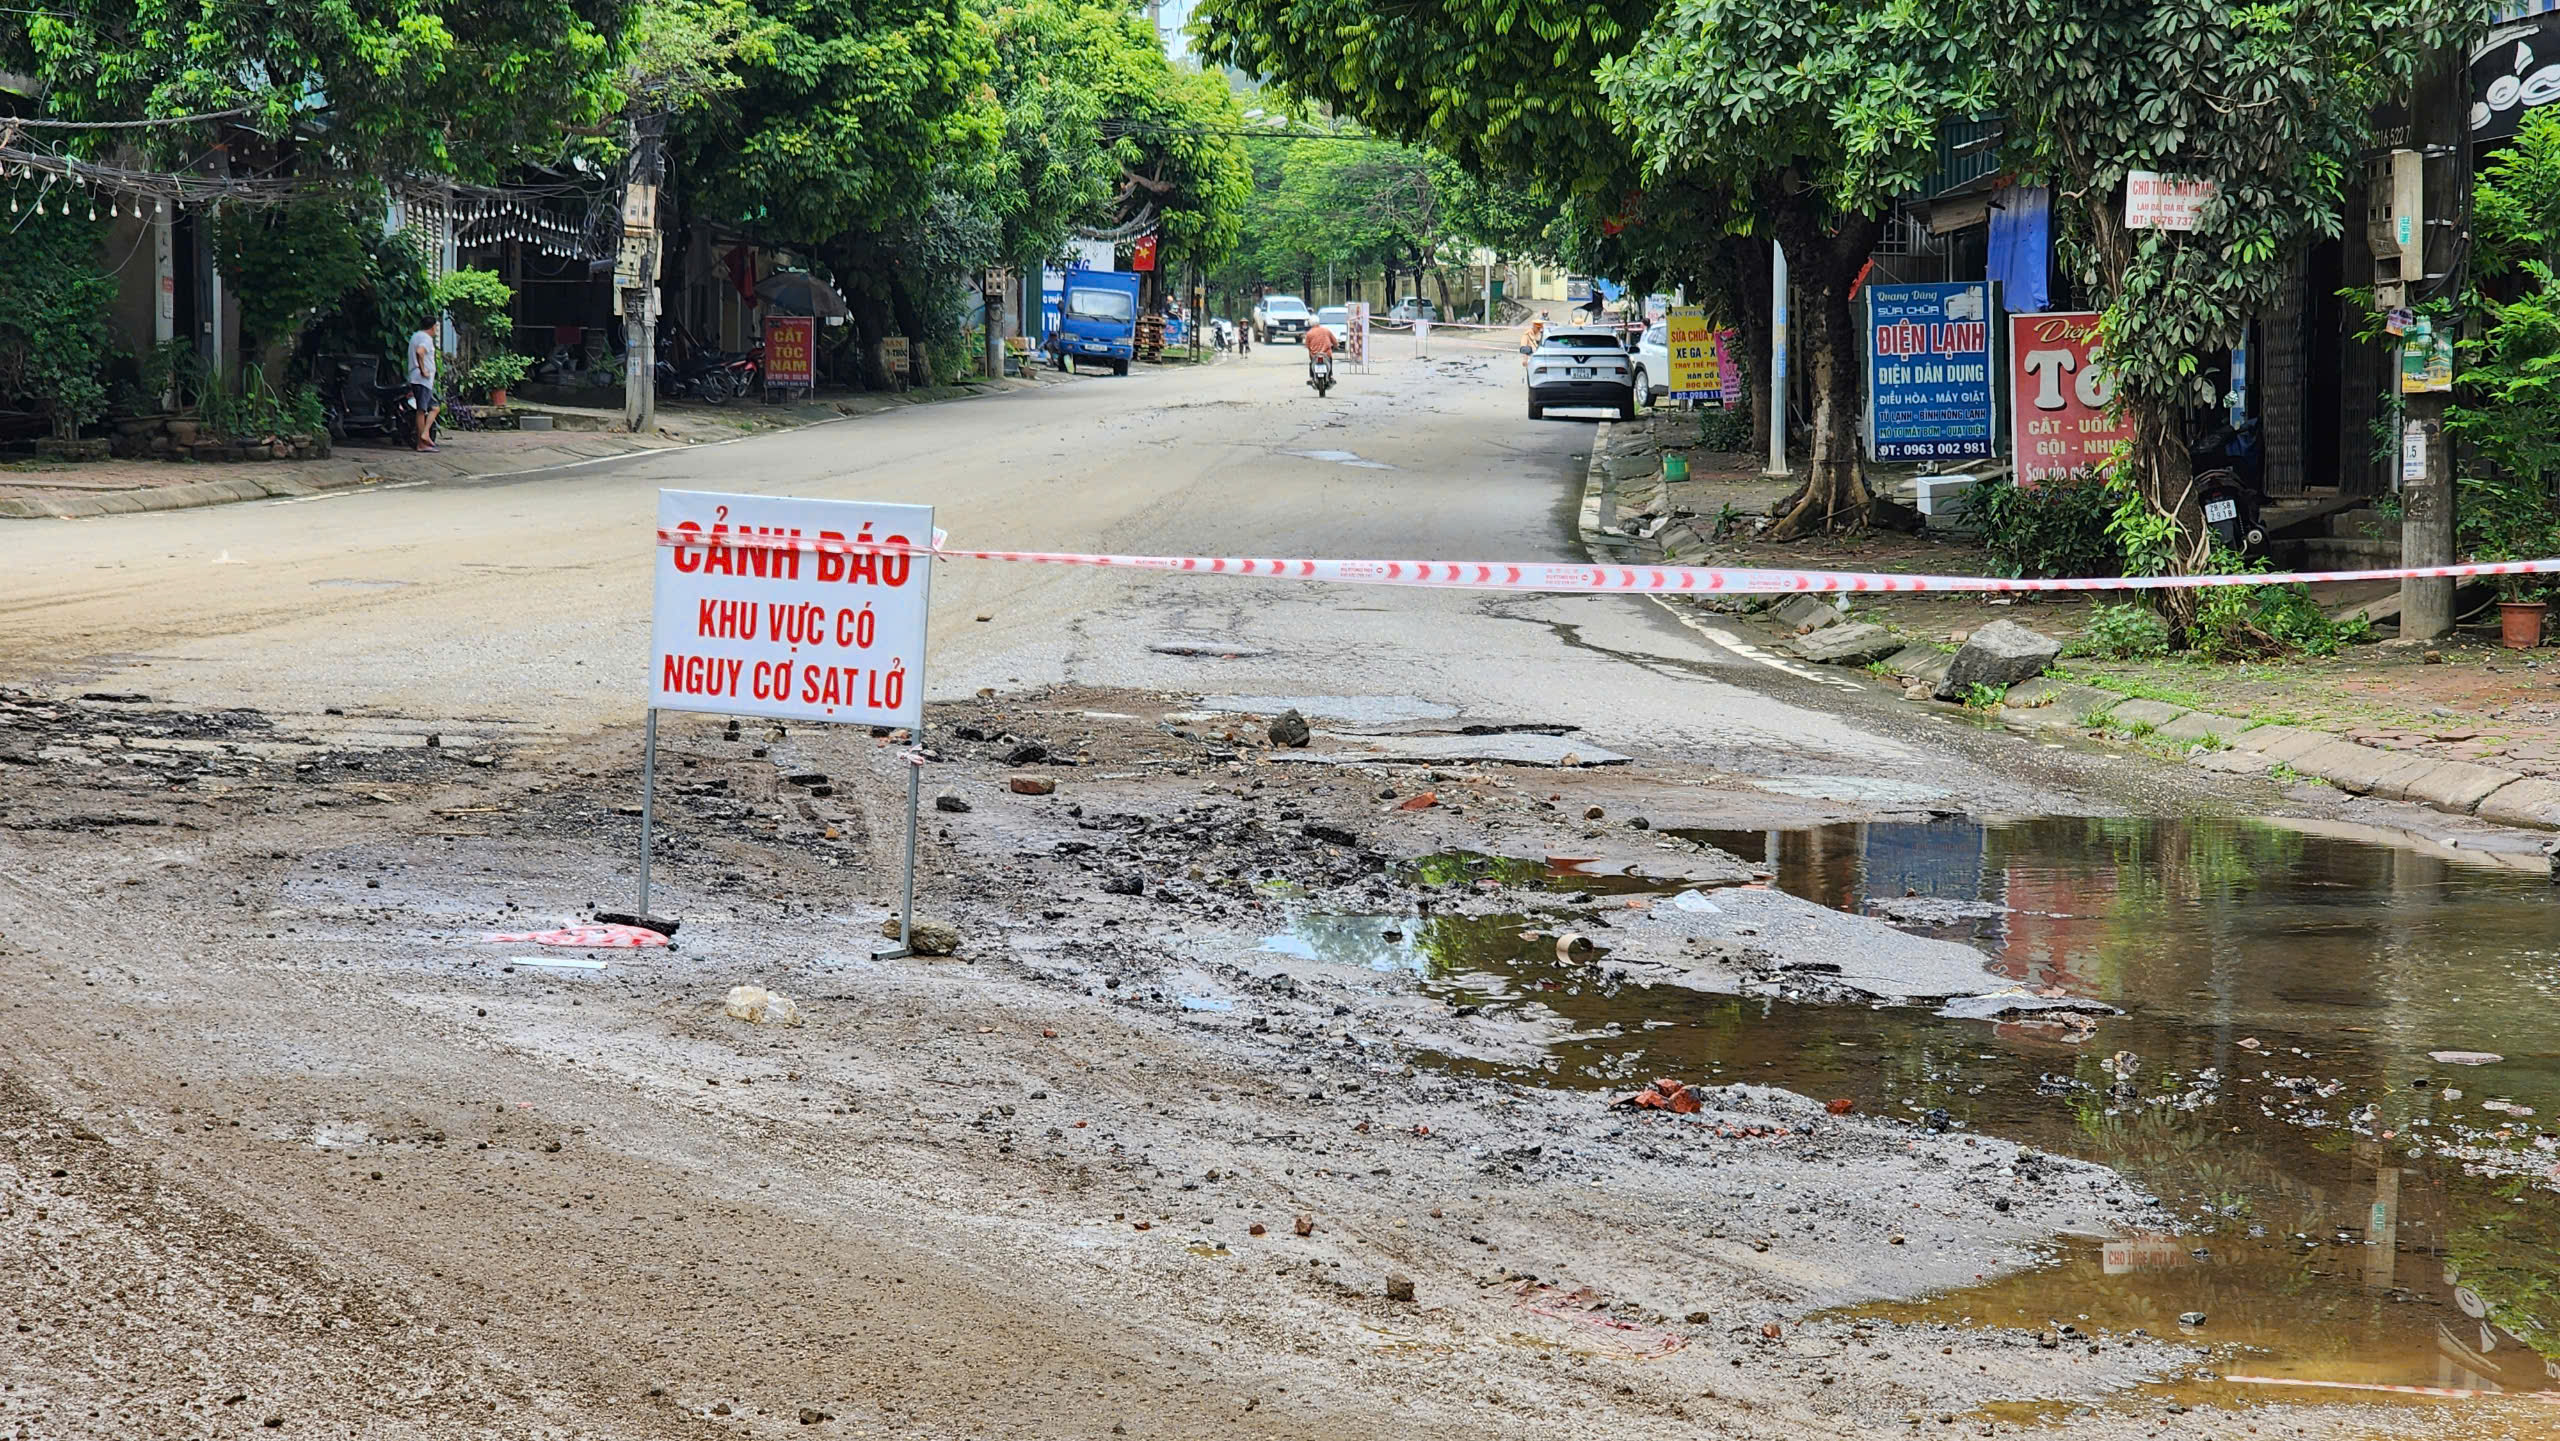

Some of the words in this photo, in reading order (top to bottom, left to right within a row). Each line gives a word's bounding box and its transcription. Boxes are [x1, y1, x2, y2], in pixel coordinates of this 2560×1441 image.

[2390, 127, 2404, 146] 522
[2133, 180, 2149, 196] CHO
[2176, 216, 2193, 226] 737
[1876, 290, 1909, 303] Quang
[1878, 304, 1904, 316] SỬA
[1906, 304, 1939, 315] CHỮA
[774, 327, 804, 343] CẮT
[1671, 328, 1686, 343] SỬA
[1688, 327, 1709, 342] CHỮA
[1877, 318, 1926, 361] ĐIỆN
[1931, 322, 1985, 360] LẠNH
[1676, 347, 1687, 359] XE
[1690, 347, 1702, 358] GA
[769, 359, 808, 371] NAM
[1878, 363, 1911, 388] ĐIỆN
[1914, 362, 1943, 384] DÂN
[1947, 364, 1984, 386] DỤNG
[1879, 390, 1902, 405] ĐIỀU
[1905, 392, 1928, 404] HÒA
[1936, 390, 1959, 403] MÁY
[1961, 390, 1985, 404] GIẶT
[1891, 411, 1913, 424] LẠNH
[1919, 408, 1939, 421] BÌNH
[1965, 408, 1986, 422] LẠNH
[1967, 423, 1986, 437] ĐIỆN
[2028, 416, 2061, 435] CẮT
[2079, 414, 2116, 433] UỐN
[1879, 444, 1900, 456] ĐT:
[1904, 444, 1934, 455] 0963
[1937, 443, 1960, 454] 002
[1964, 442, 1986, 454] 981
[2036, 438, 2066, 458] GỘI
[673, 505, 801, 581] CẢNH
[816, 522, 912, 587] BÁO
[699, 598, 757, 640] KHU
[769, 601, 825, 652] VỰC
[836, 601, 875, 649] CÓ
[663, 654, 743, 697] NGUY
[753, 659, 794, 701] CƠ
[802, 664, 859, 714] SẠT
[868, 657, 905, 710] LỞ
